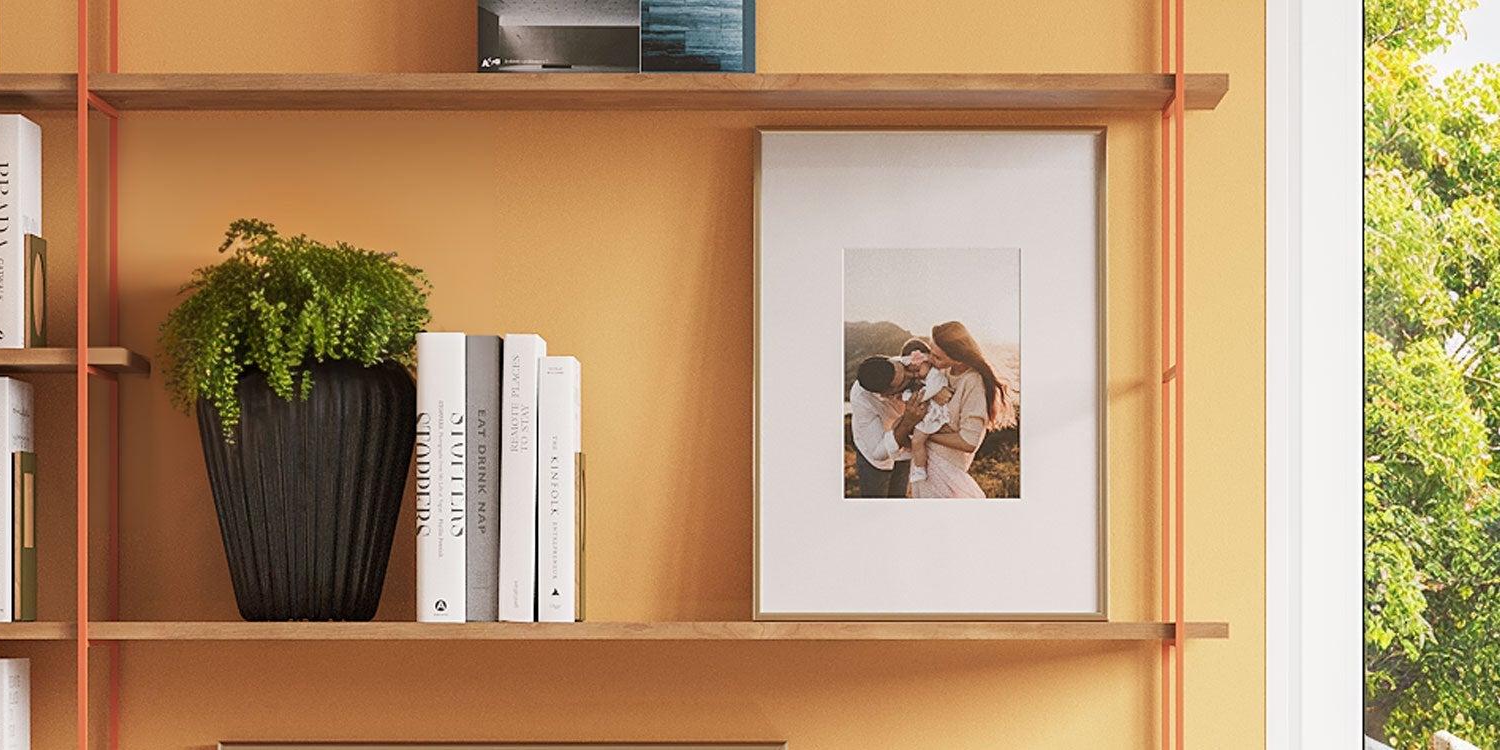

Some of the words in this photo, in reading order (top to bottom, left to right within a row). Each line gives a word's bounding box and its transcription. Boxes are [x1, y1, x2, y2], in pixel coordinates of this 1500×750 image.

[477, 409, 486, 437] EAT
[477, 444, 486, 494] DRINK
[550, 456, 559, 516] KINFOLK
[477, 502, 486, 534] NAP
